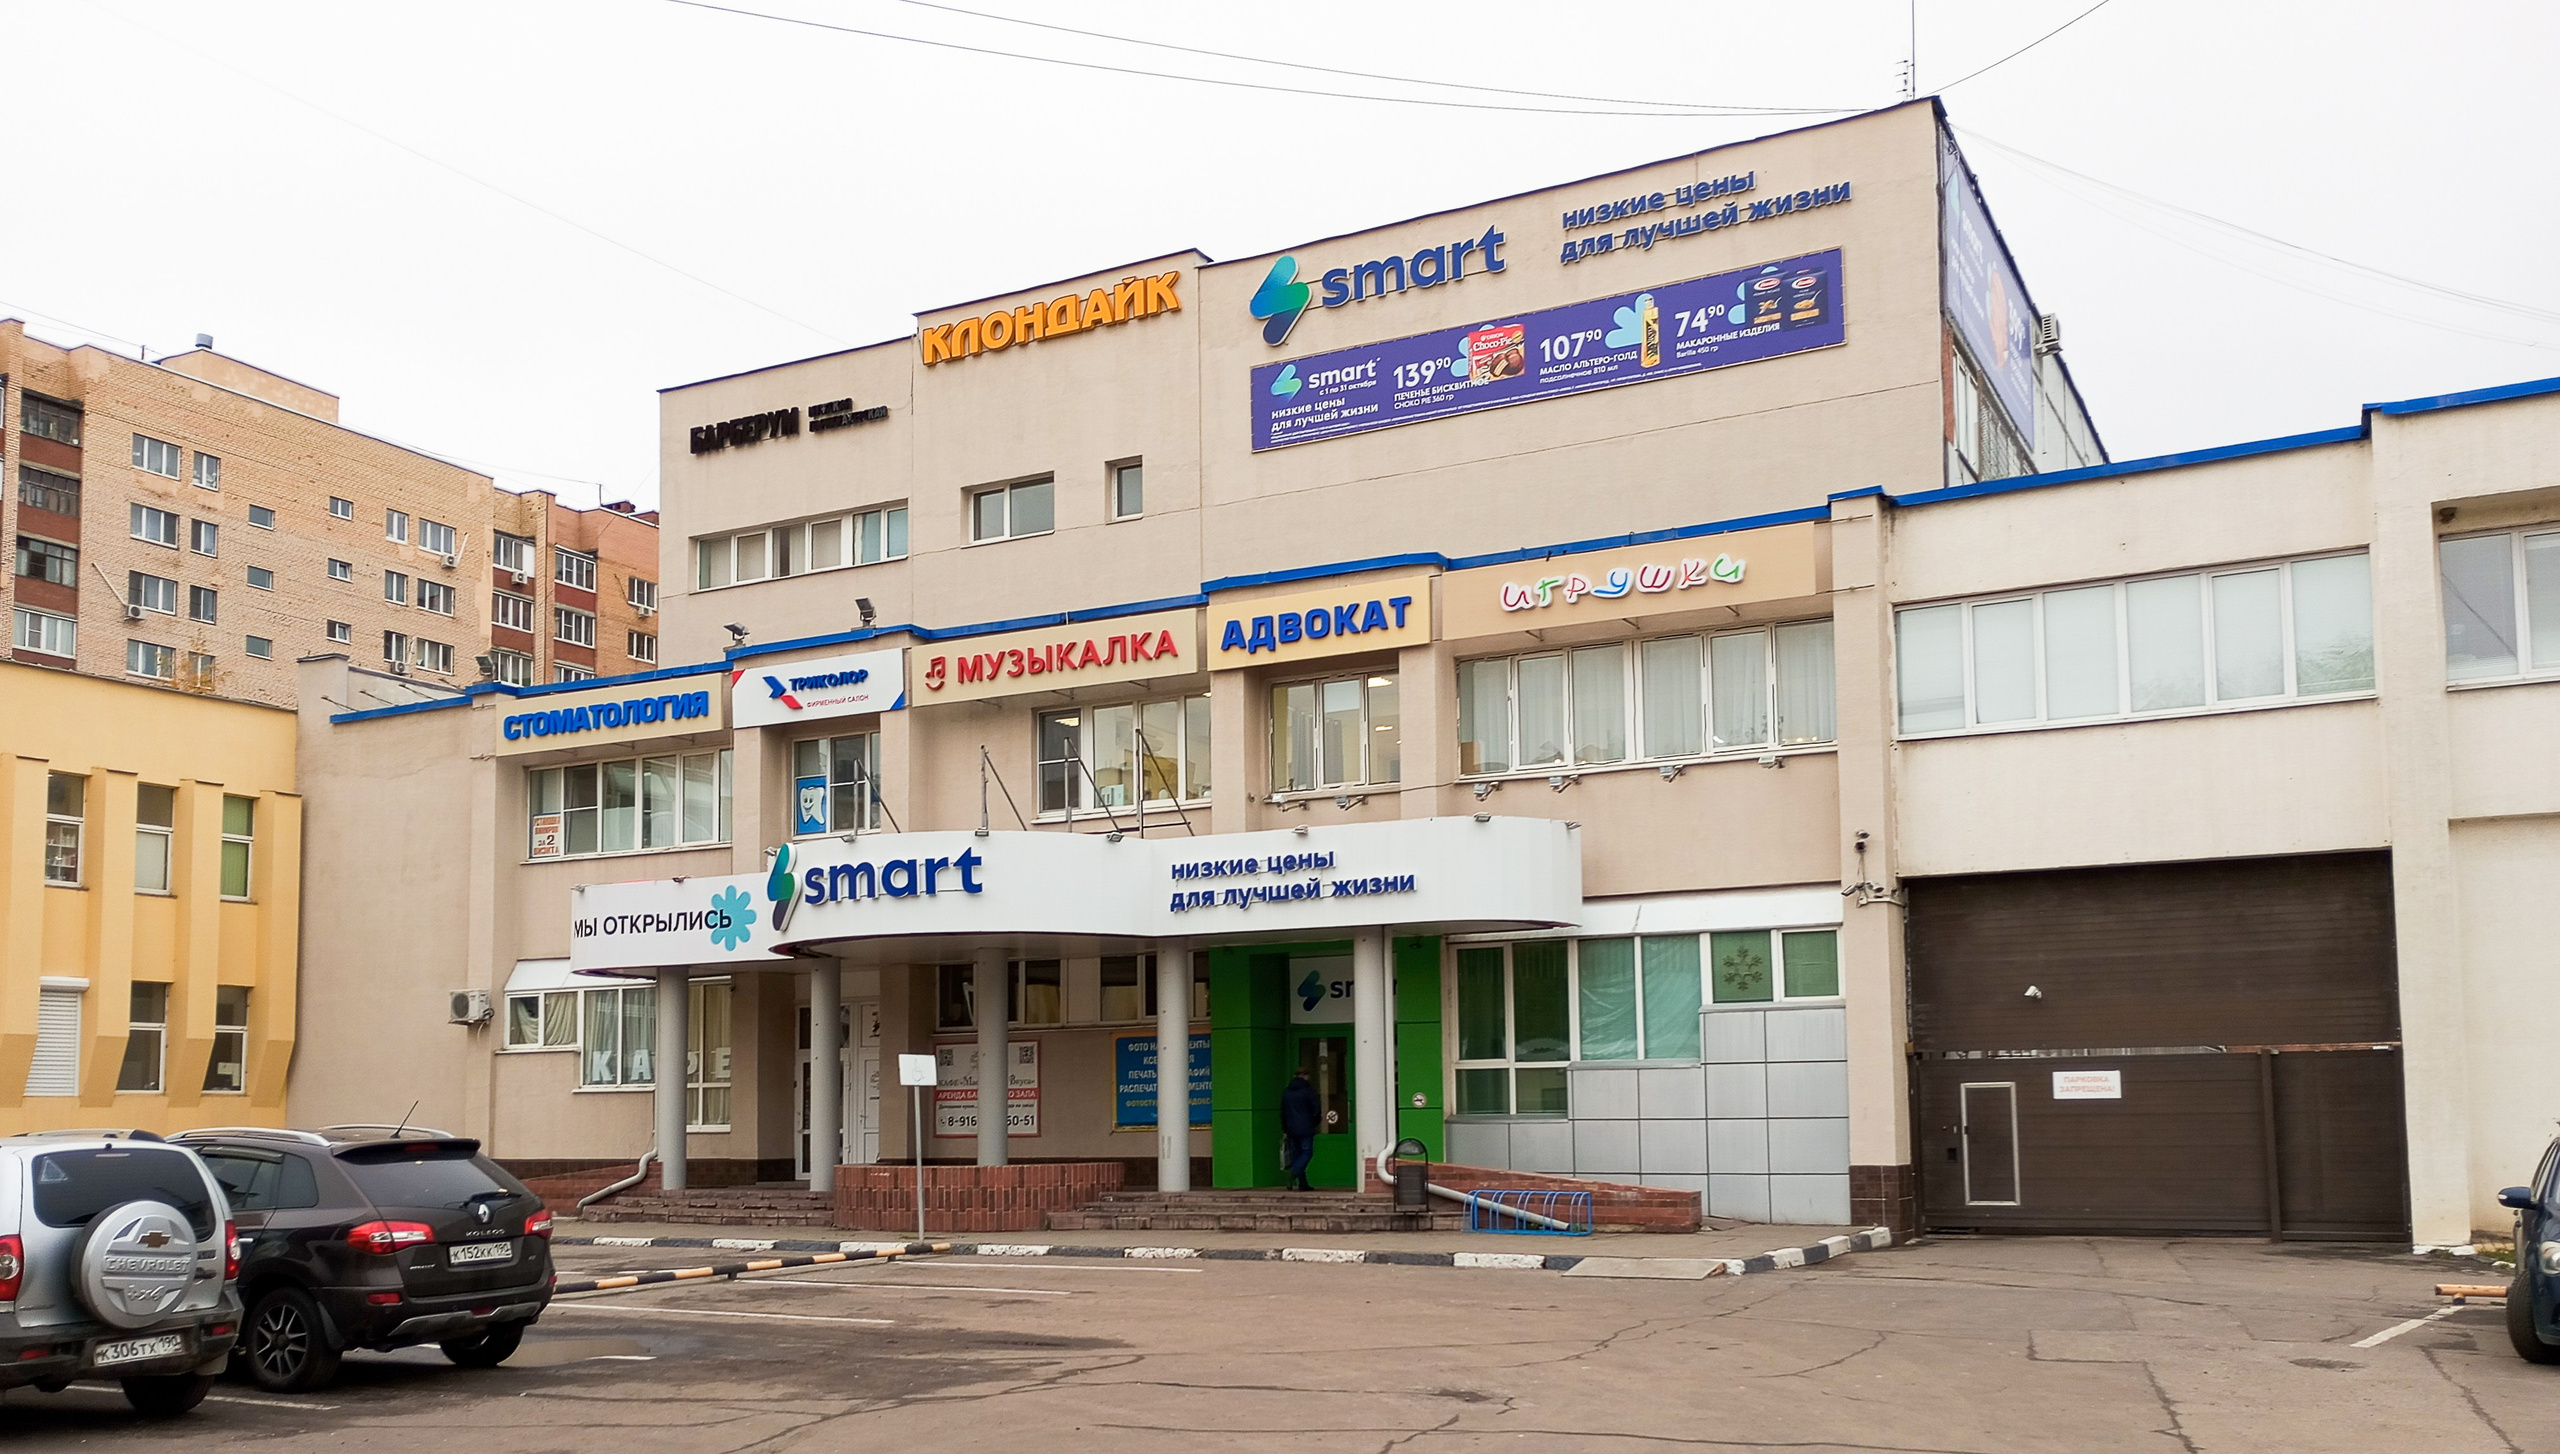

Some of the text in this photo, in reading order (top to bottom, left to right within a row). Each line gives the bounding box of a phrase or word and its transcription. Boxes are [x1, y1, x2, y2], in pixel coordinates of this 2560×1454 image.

[1562, 170, 1757, 230] низкие цены
[1560, 180, 1853, 265] для лучшей жизни
[1321, 224, 1506, 308] smart
[922, 270, 1181, 366] КЛОНДАЙК
[1676, 331, 1738, 350] МАКАРОННЫЕ
[1739, 322, 1780, 338] ИЗДЕЛИЯ
[1539, 350, 1638, 376] МАСЛО АЛЬТЕРО-ГОЛД
[1394, 376, 1492, 402] ПЕЧЕНЬЕ БИСКВИТНОЕ
[1271, 397, 1346, 420] низкие цены
[1271, 420, 1292, 432] для
[1293, 408, 1339, 428] лучшей
[1340, 403, 1379, 419] жизни
[690, 406, 800, 454] БАРБЕРУМ
[1221, 596, 1412, 654] АДВОКАТ
[957, 629, 1178, 684] МУЗЫКАЛКА
[789, 669, 869, 692] ТРИКОЛОР
[807, 694, 869, 708] ФИРМЕННЫЙ САЛОН
[504, 691, 709, 741] СТОМАТОЛОГИЯ
[805, 846, 984, 906] smart
[1171, 851, 1335, 881] низкие цены
[1170, 874, 1417, 913] для лучшей жизни
[573, 909, 732, 938] МЫ ОТКРЫЛИСЬ
[1128, 1042, 1149, 1052] ФОТО
[1120, 1083, 1158, 1093] РАСПЕЧАТ
[1128, 1070, 1157, 1079] ПЕЧАТЬ
[106, 1258, 190, 1272] CHEVROLET
